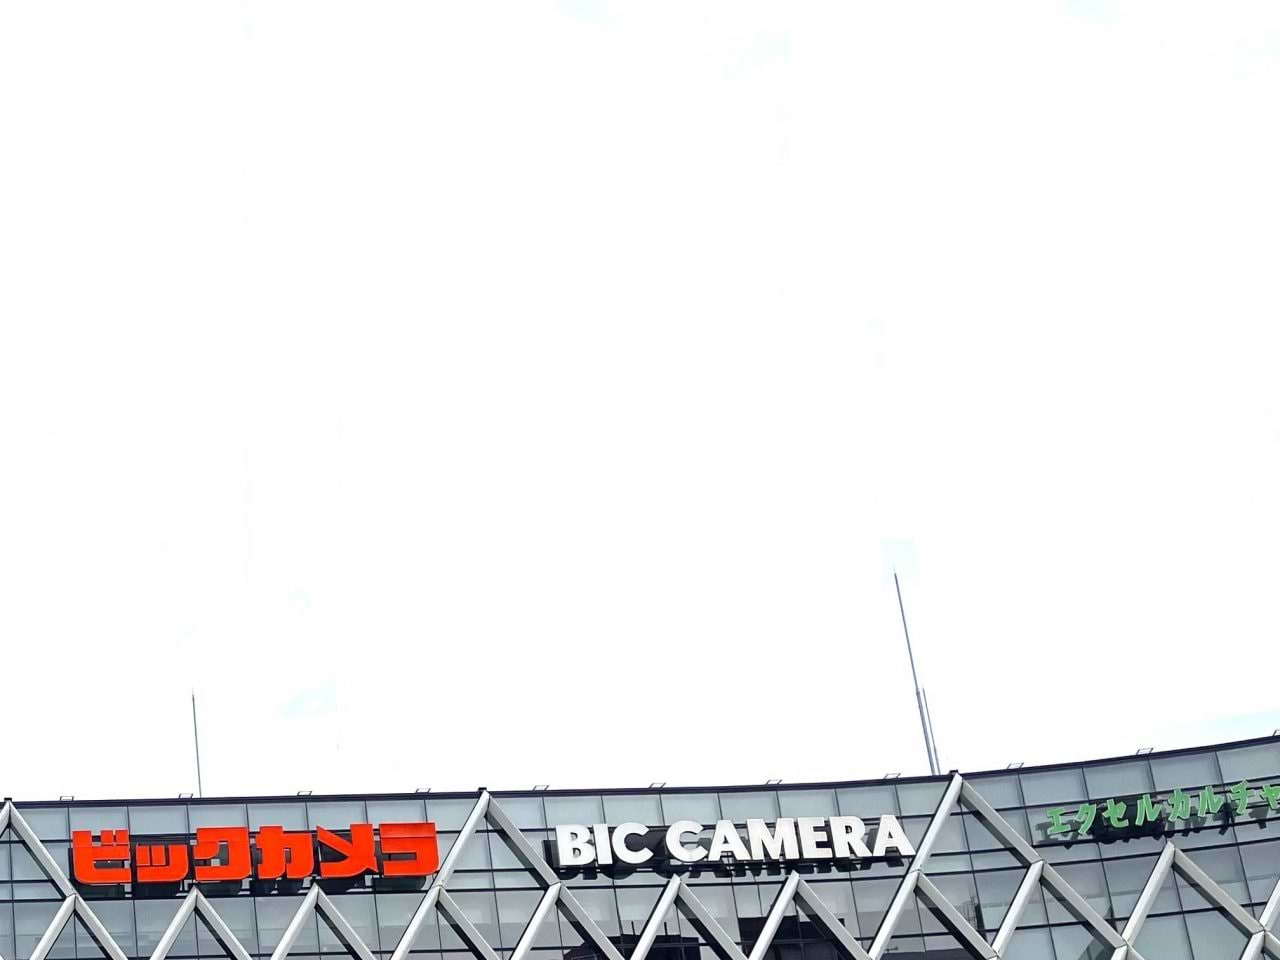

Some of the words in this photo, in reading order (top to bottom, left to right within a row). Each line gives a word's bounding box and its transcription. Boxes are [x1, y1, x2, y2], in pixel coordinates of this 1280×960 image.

[72, 823, 440, 885] ビックカメラ
[555, 822, 654, 866] BIC
[665, 814, 916, 863] CAMERA
